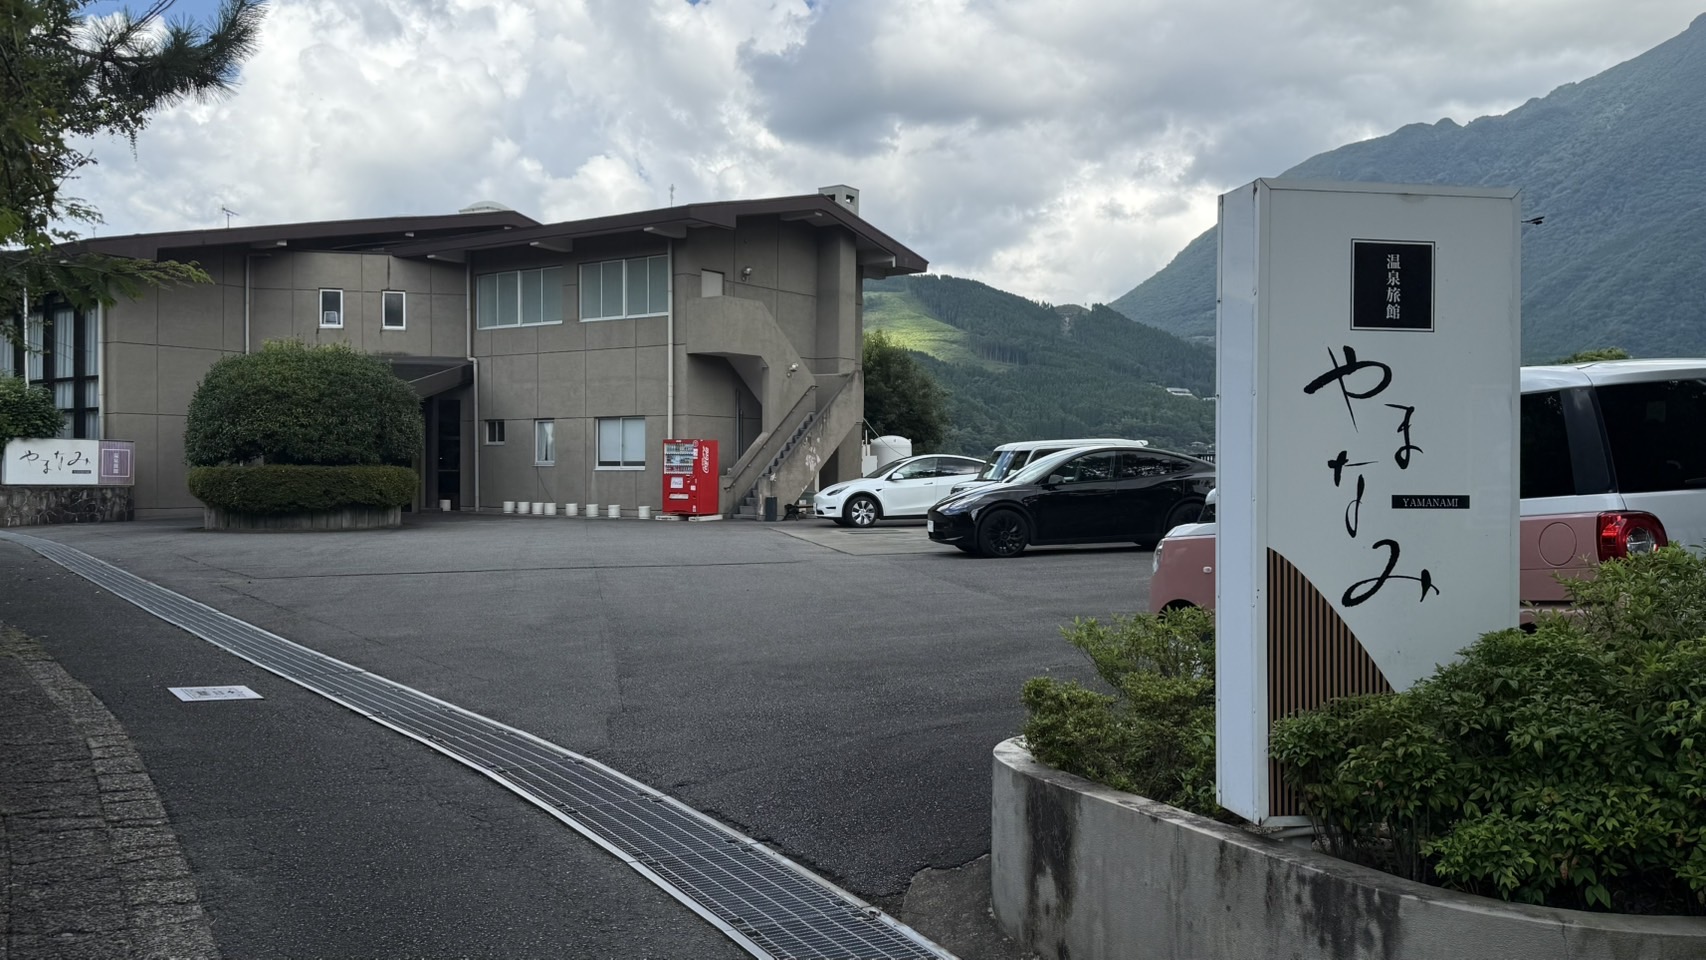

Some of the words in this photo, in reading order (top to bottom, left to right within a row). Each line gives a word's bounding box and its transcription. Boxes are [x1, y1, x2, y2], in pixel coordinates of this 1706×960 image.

[1386, 254, 1401, 320] 温泉旅館
[19, 450, 90, 474] やまなみ
[1303, 345, 1439, 607] やまなみ
[1402, 498, 1459, 507] YAMANAMI
